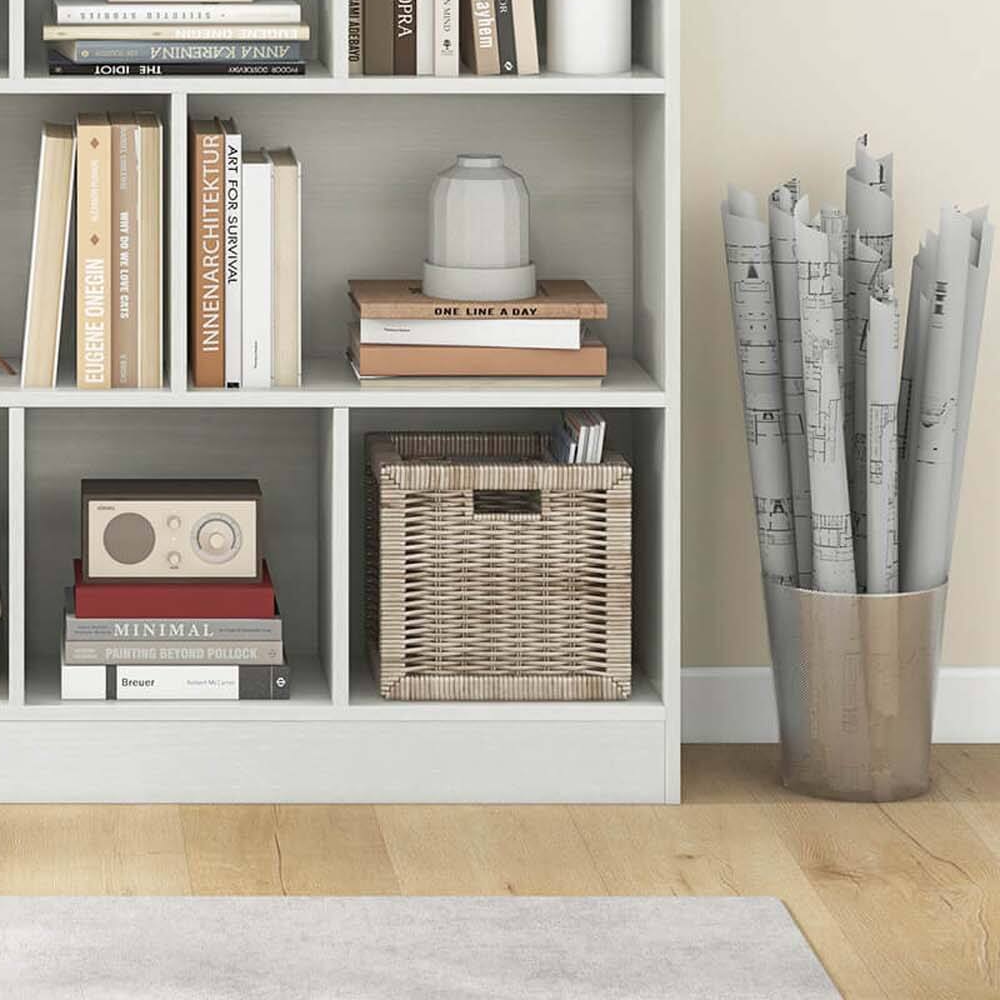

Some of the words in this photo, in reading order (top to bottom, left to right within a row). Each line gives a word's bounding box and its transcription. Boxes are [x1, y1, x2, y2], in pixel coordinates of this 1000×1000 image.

[150, 45, 237, 59] KARENINA
[240, 45, 291, 59] ANNA
[94, 65, 131, 75] IDIOT
[139, 65, 162, 75] THE
[227, 144, 239, 173] ART
[227, 179, 239, 211] FOR
[202, 134, 220, 352] INNENARCHITEKTUR
[227, 215, 239, 285] SURVIVAL
[84, 258, 105, 317] ONEGIN
[434, 307, 459, 316] ONE
[466, 307, 495, 316] LINE
[499, 307, 510, 316] A
[512, 307, 538, 316] DAY
[84, 321, 105, 383] EUGENE
[113, 623, 214, 637] MINIMAL
[105, 647, 158, 660] PAINTING
[159, 647, 206, 660] BEYOND
[207, 647, 258, 660] POLLOCK
[121, 677, 155, 687] Breuer
